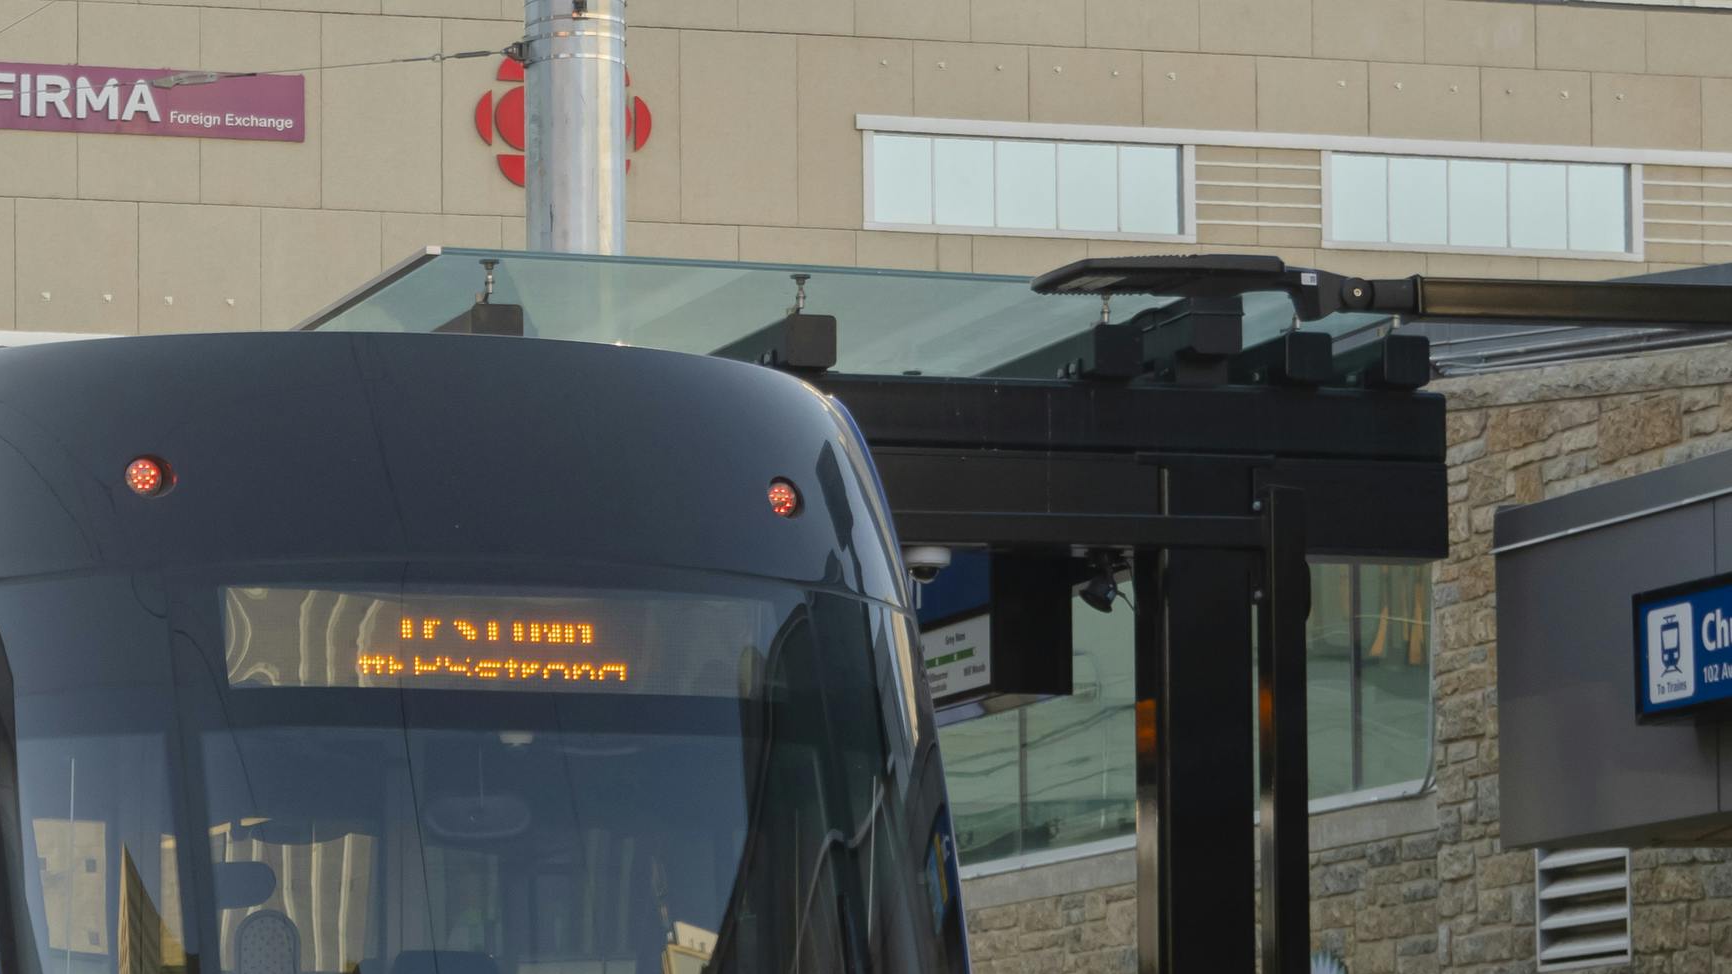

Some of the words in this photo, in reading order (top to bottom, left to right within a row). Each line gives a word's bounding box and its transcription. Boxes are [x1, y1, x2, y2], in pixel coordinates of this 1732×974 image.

[169, 110, 221, 127] Foreign
[225, 114, 294, 130] Exchange
[1702, 608, 1732, 651] Ch
[1703, 664, 1720, 684] 102
[1658, 684, 1666, 695] To
[1667, 681, 1686, 692] Trains
